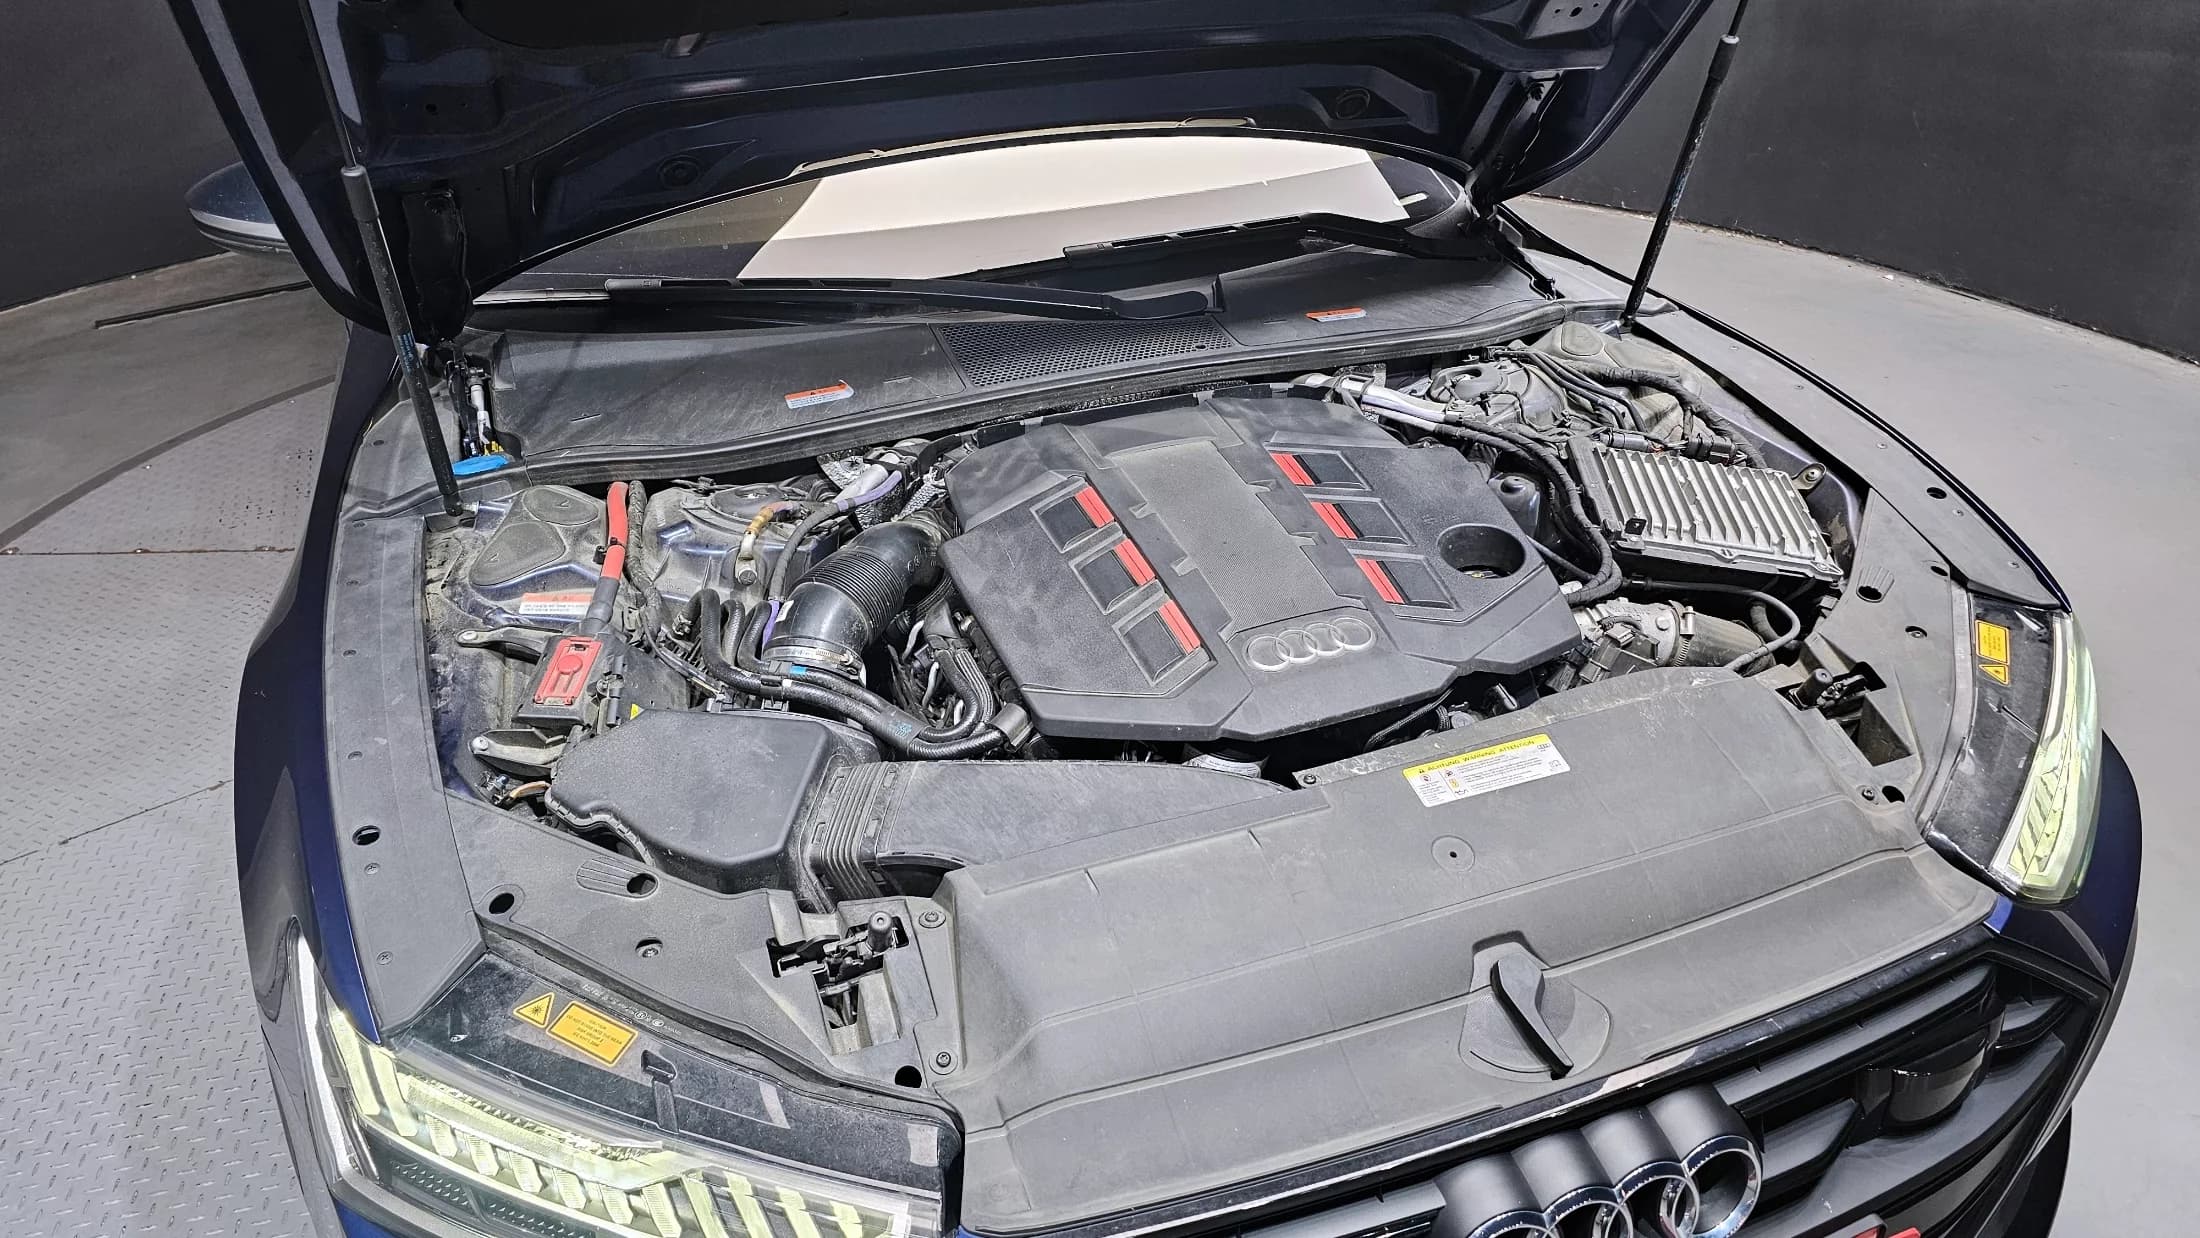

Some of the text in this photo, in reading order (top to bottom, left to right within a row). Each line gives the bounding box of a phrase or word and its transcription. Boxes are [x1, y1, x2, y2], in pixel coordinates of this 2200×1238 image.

[1427, 759, 1461, 771] ACHTUNG
[1463, 751, 1496, 762] WARNING
[1499, 740, 1535, 753] ATTENTION
